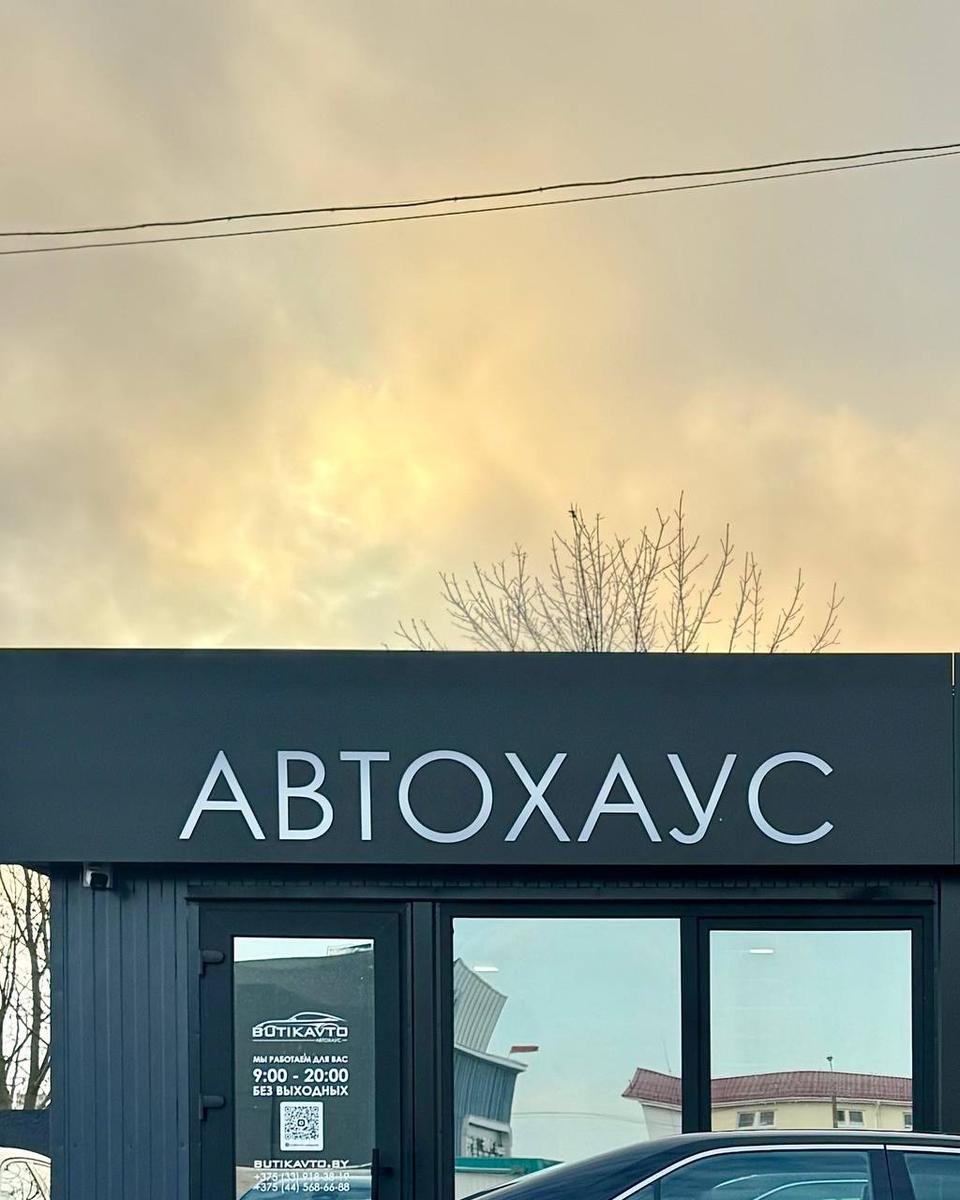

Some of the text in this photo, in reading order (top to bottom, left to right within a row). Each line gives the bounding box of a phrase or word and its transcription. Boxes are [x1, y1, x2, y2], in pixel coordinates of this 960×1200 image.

[178, 749, 834, 845] АВТОХАУС
[252, 1026, 348, 1038] BUTIKAVTO
[252, 1055, 268, 1063] МЫ
[331, 1055, 349, 1063] ВАС
[252, 1068, 288, 1083] 9:00
[303, 1068, 349, 1083] 20:00
[252, 1085, 349, 1097] БЕЗ ВЫХОДНЫХ
[253, 1159, 350, 1168] BUTIKAVTO.BY
[253, 1182, 350, 1194] +375 (44) 568-66-88
